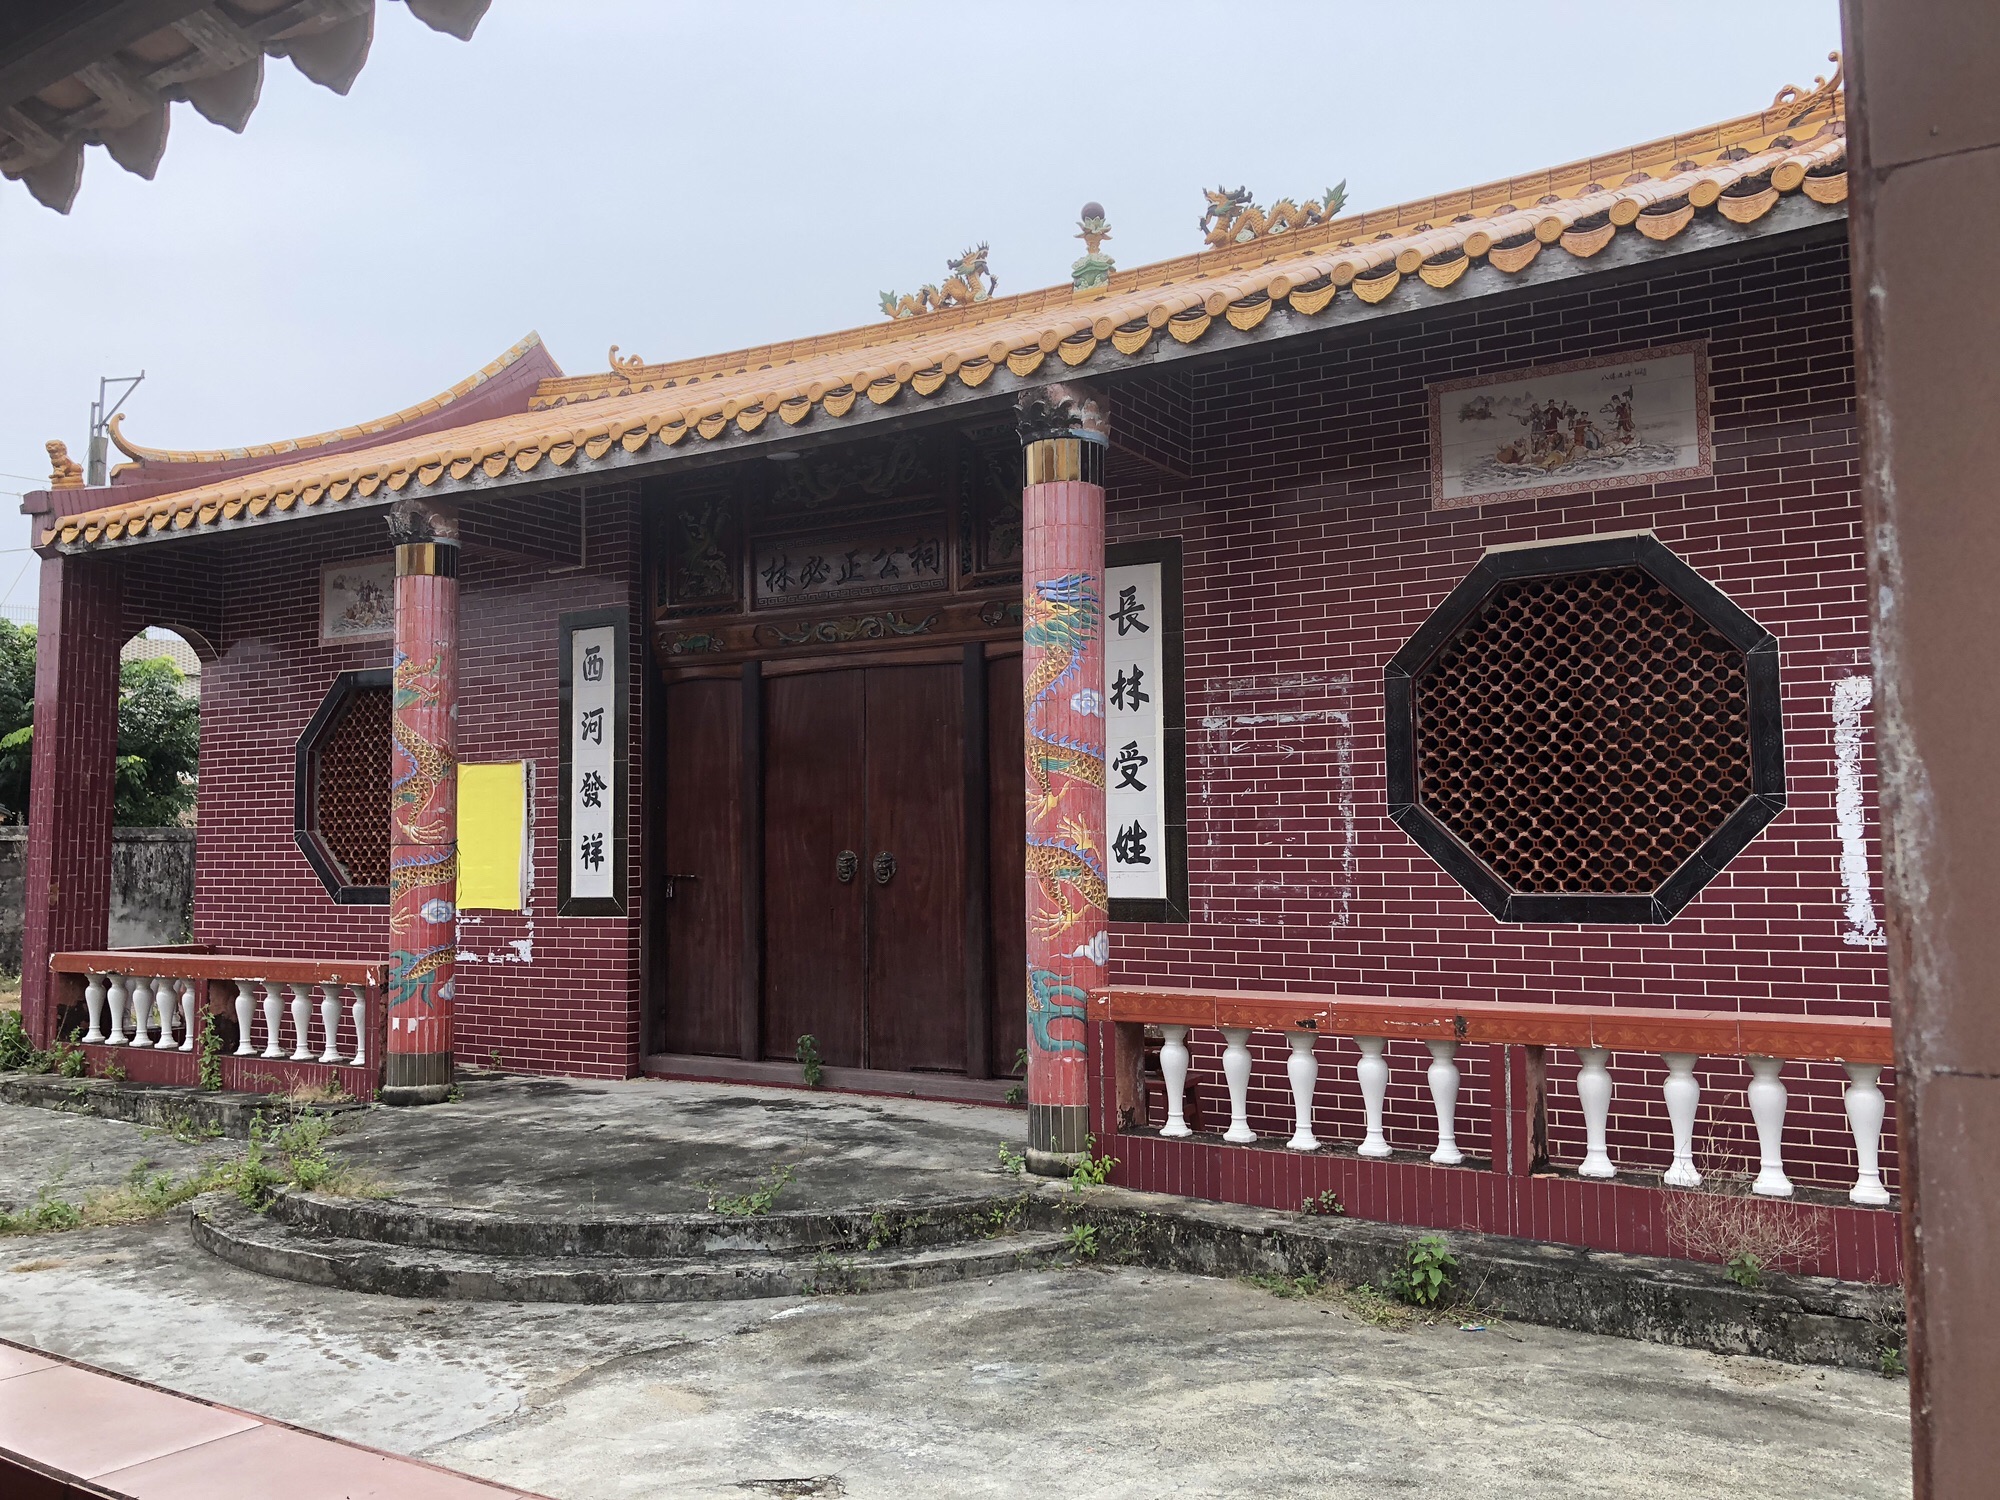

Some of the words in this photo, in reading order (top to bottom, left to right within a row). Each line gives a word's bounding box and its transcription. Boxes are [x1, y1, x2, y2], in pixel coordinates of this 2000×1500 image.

[579, 645, 607, 873] 西河發祥
[1108, 585, 1151, 865] 長林受姓
